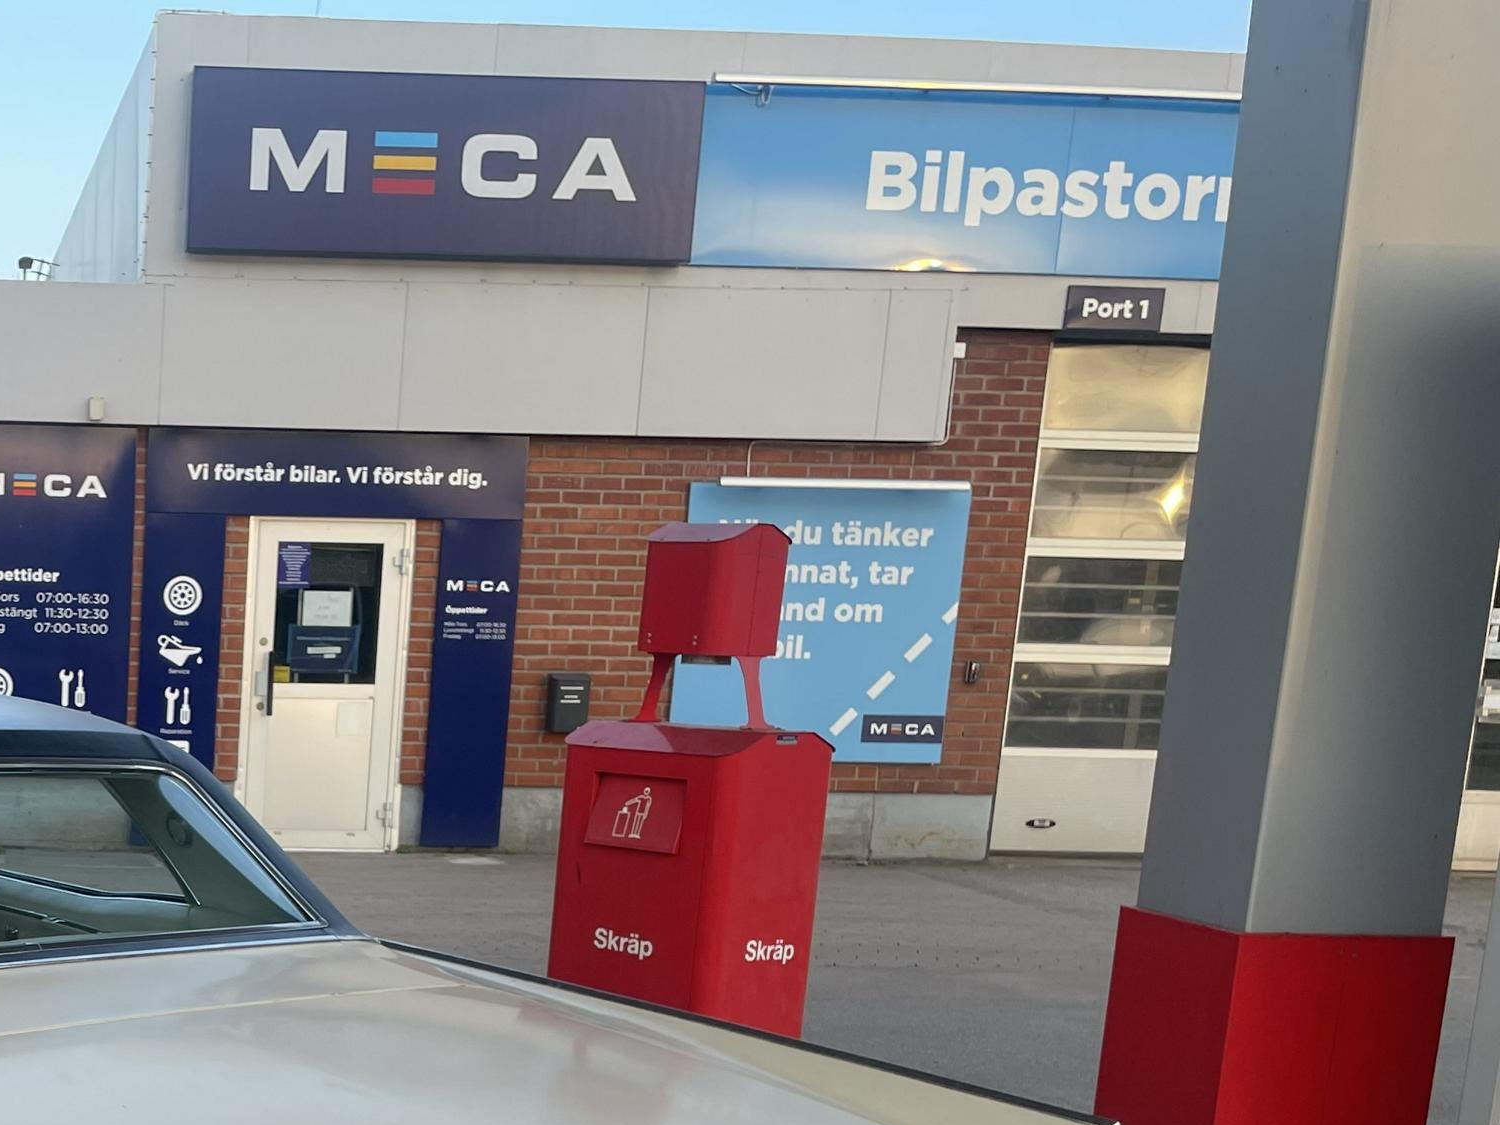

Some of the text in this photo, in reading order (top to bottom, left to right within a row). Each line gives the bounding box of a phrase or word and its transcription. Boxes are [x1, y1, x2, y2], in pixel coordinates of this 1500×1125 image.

[250, 127, 636, 202] MECA
[1081, 297, 1150, 320] Port 1
[187, 461, 489, 490] Vi förstår bilar. Vi förstår dig.
[831, 520, 935, 547] tänker
[869, 561, 915, 586] tar
[446, 579, 510, 593] MECA
[35, 592, 110, 605] 07:00-16:30
[44, 607, 109, 620] 11:30-12:30
[445, 605, 489, 615] Öppettider
[833, 602, 884, 623] om
[34, 622, 109, 635] 07:00-13:00
[168, 667, 191, 675] Service
[870, 722, 935, 736] MECA
[593, 927, 654, 961] Skräp
[744, 938, 795, 965] Skräp
